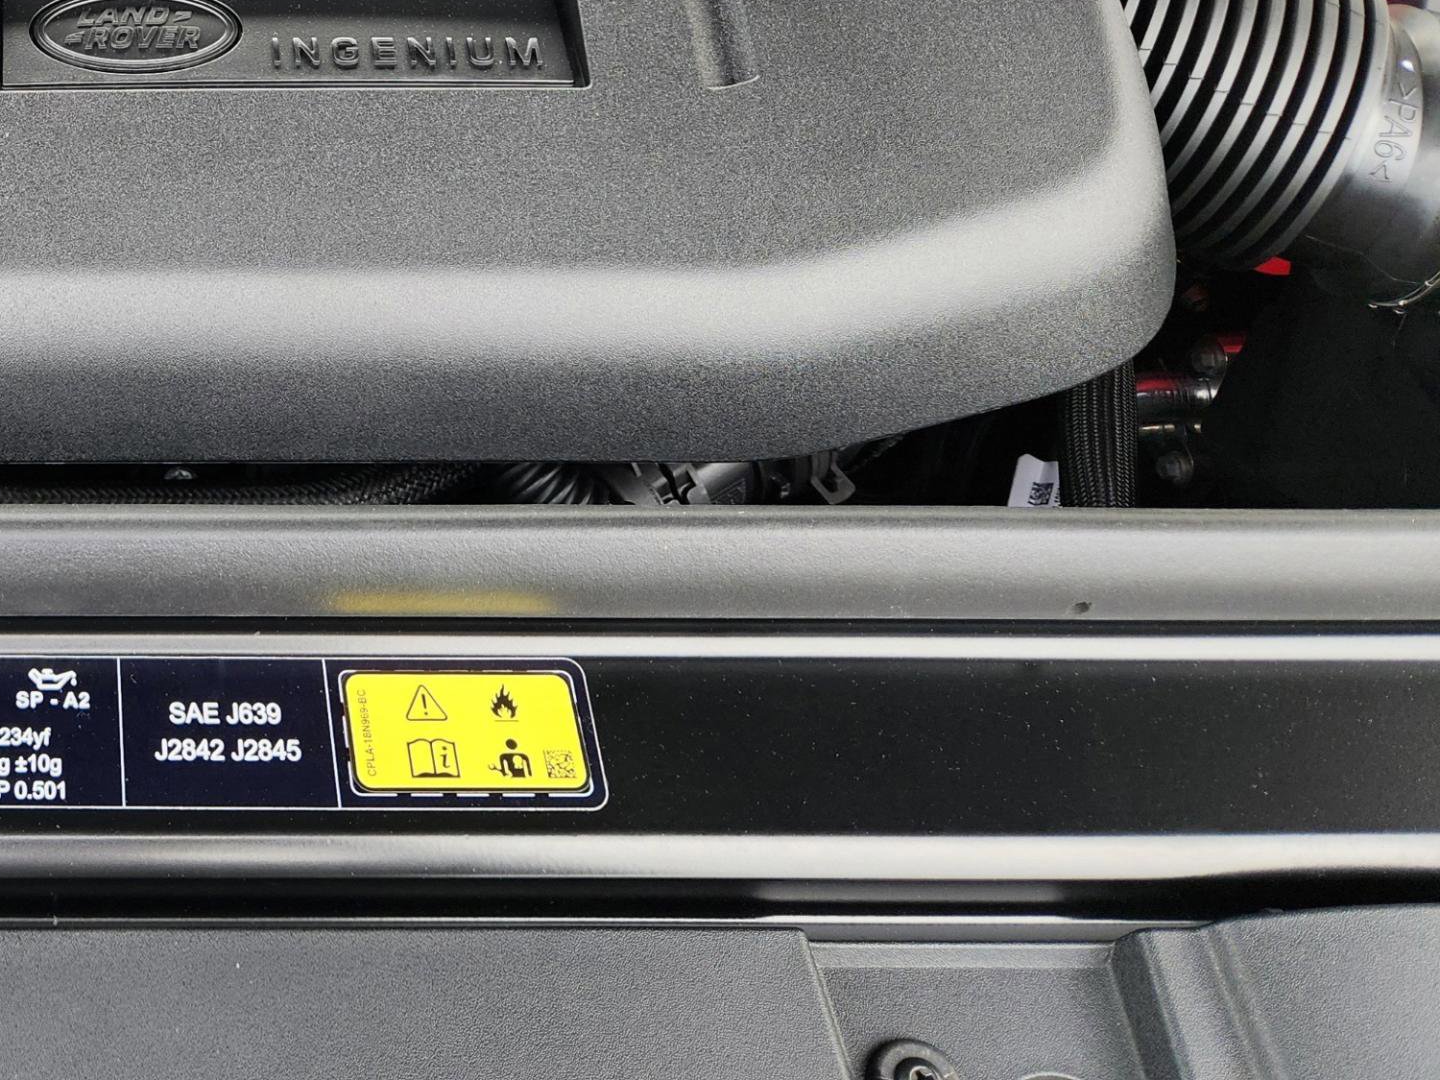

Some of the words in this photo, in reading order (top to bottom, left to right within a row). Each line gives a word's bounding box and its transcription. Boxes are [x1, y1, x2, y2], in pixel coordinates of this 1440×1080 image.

[76, 7, 170, 28] LAND
[84, 25, 201, 50] ROVER
[270, 35, 544, 71] INGENIUM
[15, 691, 44, 709] SP
[63, 691, 91, 709] A2
[168, 702, 220, 725] SAE
[225, 702, 282, 725] J639
[154, 738, 226, 762] J2842
[230, 738, 302, 762] J2845
[14, 753, 63, 778] ±10g
[13, 781, 67, 800] 0.501
